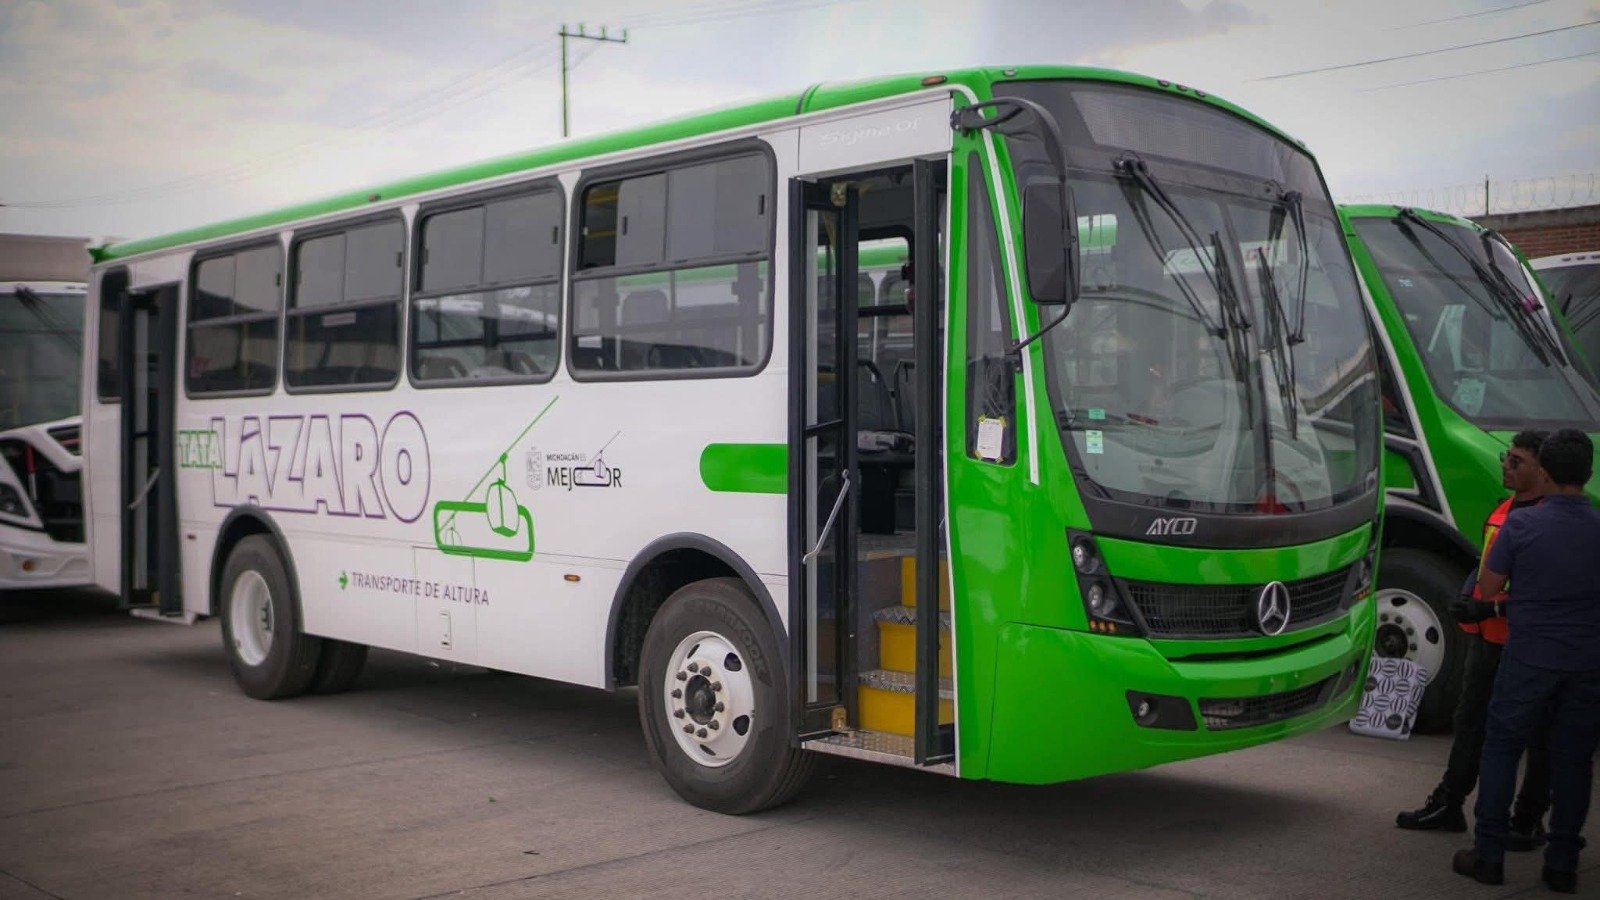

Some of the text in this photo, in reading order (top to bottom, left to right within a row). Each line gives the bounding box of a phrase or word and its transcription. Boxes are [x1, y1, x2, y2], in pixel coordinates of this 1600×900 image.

[179, 430, 222, 468] TATA
[210, 411, 431, 523] LÁZARO
[547, 466, 622, 491] MEJOR
[1145, 517, 1198, 535] AYCO
[351, 572, 490, 606] TRANSPORTE DE ALTURA
